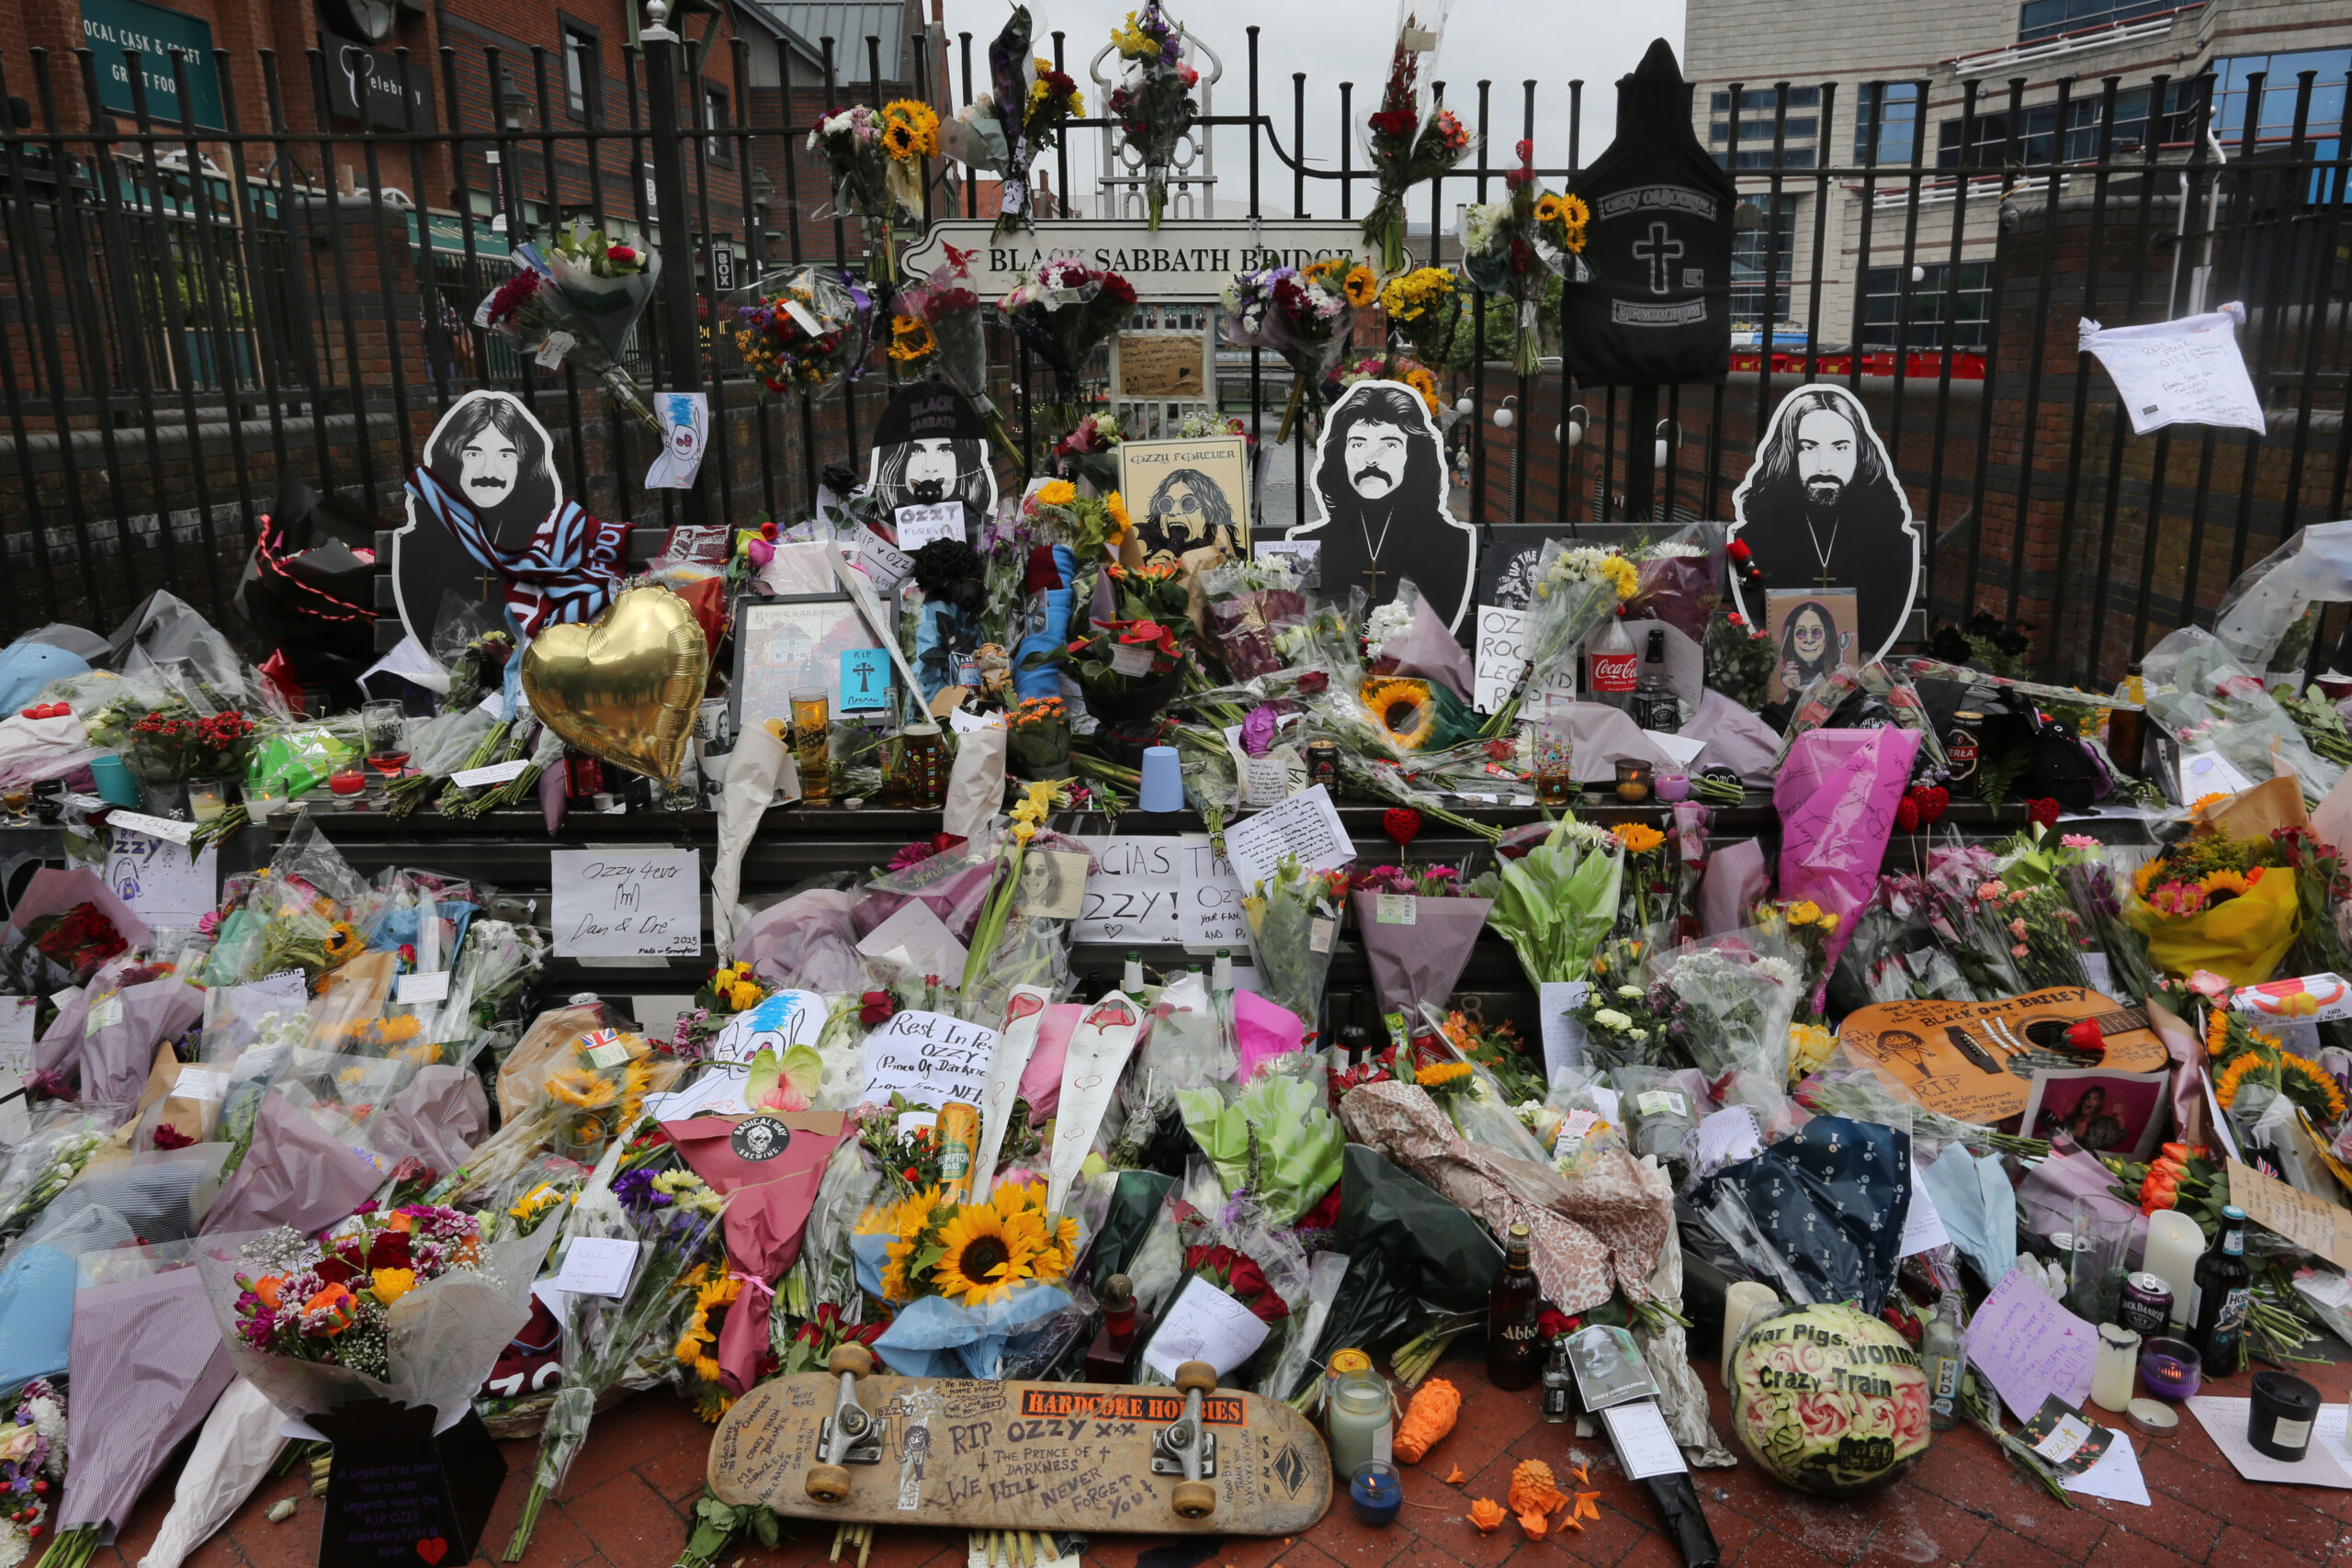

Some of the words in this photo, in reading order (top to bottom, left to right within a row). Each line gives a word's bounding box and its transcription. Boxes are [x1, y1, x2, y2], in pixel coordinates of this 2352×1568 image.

[84, 19, 116, 42] OCAL
[120, 29, 151, 51] CASK
[154, 39, 164, 55] &
[111, 64, 149, 87] GRT
[153, 73, 176, 93] FOO
[340, 45, 421, 107] Celebry
[717, 253, 729, 287] BOX
[1095, 248, 1230, 273] SABBATH
[910, 395, 956, 417] BLACK
[910, 415, 956, 434] SABBATH
[1130, 451, 1170, 466] OZZY
[900, 503, 960, 525] OZZY
[855, 531, 875, 550] RIP
[885, 551, 910, 570] OZZ
[1483, 612, 1524, 635] OZ
[854, 650, 872, 659] RIP
[1480, 637, 1525, 661] ROC
[1477, 660, 1573, 689] LEGND
[1595, 659, 1638, 680] Coca-Col
[1492, 687, 1543, 715] RP
[120, 829, 138, 840] RIP
[582, 862, 636, 885] Ozzy
[640, 861, 684, 880] 4ever
[1184, 846, 1237, 878] Tha
[1084, 890, 1179, 924] ZZY!
[1197, 886, 1241, 908] OZ
[570, 913, 609, 942] Dan
[615, 918, 633, 932] &
[1221, 912, 1241, 921] FAN
[673, 936, 697, 945] 2025
[1204, 931, 1223, 939] AND
[664, 947, 698, 956] Birmingham
[1919, 1009, 1974, 1027] BLACK
[1977, 1003, 2014, 1016] OUT
[888, 1012, 937, 1039] Rest
[940, 1023, 967, 1045] In
[971, 1031, 993, 1051] Pea
[921, 1043, 979, 1064] OZZY
[934, 1059, 989, 1078] Darkne
[734, 1117, 773, 1136] RADICAL
[772, 1122, 788, 1137] WAY
[739, 1146, 779, 1159] BREWING
[943, 1163, 960, 1171] OAKS
[1609, 1381, 1647, 1395] OSBOURNE
[1759, 1365, 1821, 1393] Crazy
[1831, 1366, 1893, 1397] Train
[1939, 1360, 1954, 1394] WKD
[787, 1384, 799, 1394] NO
[793, 1391, 813, 1401] MORE
[949, 1387, 971, 1395] HOME
[741, 1393, 772, 1429] CHANGES
[791, 1399, 816, 1407] TEARS
[948, 1404, 961, 1413] WE
[979, 1401, 1001, 1409] OZZY
[1029, 1393, 1143, 1418] HARDCORE
[1148, 1398, 1241, 1422] HOIES
[746, 1436, 764, 1461] CRAZY
[762, 1408, 780, 1433] TRAIN
[761, 1416, 789, 1456] DREAMER
[1007, 1419, 1088, 1443] OZZY
[993, 1449, 1020, 1462] THE
[1023, 1447, 1069, 1461] PRINCE
[1075, 1446, 1091, 1458] OF
[1261, 1435, 1271, 1494] VANS
[338, 1469, 347, 1478] A
[350, 1465, 390, 1480] Legend
[391, 1464, 411, 1474] has
[413, 1463, 440, 1474] been
[738, 1466, 757, 1484] MR
[1004, 1459, 1079, 1476] DARKNESS
[1221, 1459, 1231, 1478] BYE
[360, 1483, 379, 1493] laid
[382, 1483, 394, 1492] to
[946, 1475, 983, 1506] WE
[989, 1477, 1040, 1504] WILL
[1040, 1467, 1103, 1509] NEVER
[1222, 1478, 1234, 1503] GOOD
[1235, 1469, 1244, 1492] THANK
[343, 1498, 387, 1513] Legends
[390, 1498, 419, 1506] never
[423, 1495, 440, 1506] die
[1070, 1473, 1133, 1514] FORGET
[390, 1511, 420, 1523] OZZY
[428, 1526, 440, 1538] &
